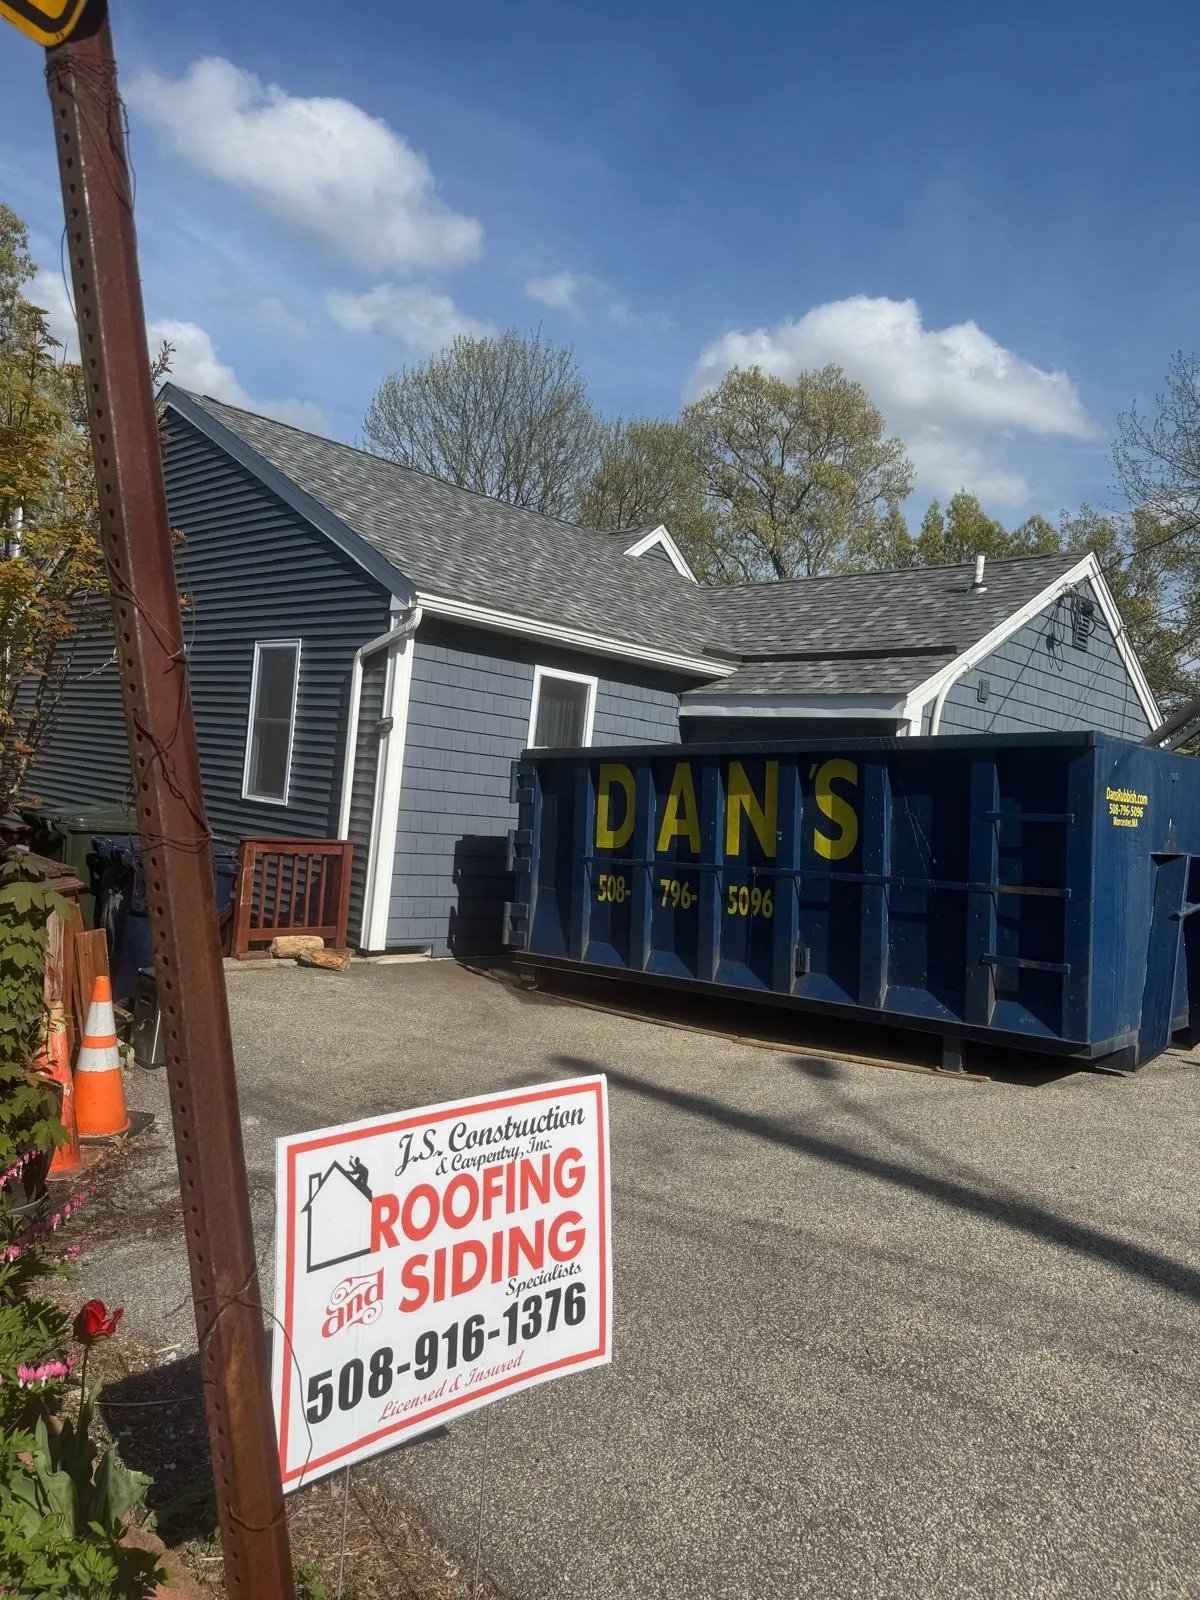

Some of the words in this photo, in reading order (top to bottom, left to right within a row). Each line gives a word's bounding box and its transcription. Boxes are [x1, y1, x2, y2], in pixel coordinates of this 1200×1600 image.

[596, 758, 858, 860] DAN'S
[1109, 803, 1144, 818] 508-796-5096
[598, 874, 631, 903] 508-
[660, 879, 698, 909] 796-
[727, 885, 774, 918] 5096
[395, 1129, 444, 1176] J.S.
[448, 1106, 586, 1153] Construction
[435, 1157, 449, 1176] &
[451, 1139, 524, 1174] Carpentry,
[527, 1137, 553, 1158] Inc.
[370, 1147, 586, 1253] ROOFING
[321, 1267, 384, 1338] and
[398, 1210, 586, 1313] SIDING
[505, 1264, 582, 1297] Specialists
[306, 1281, 587, 1424] 508-916-1376
[378, 1381, 446, 1422] Licensed
[449, 1374, 462, 1394] &
[464, 1349, 524, 1388] Insured
